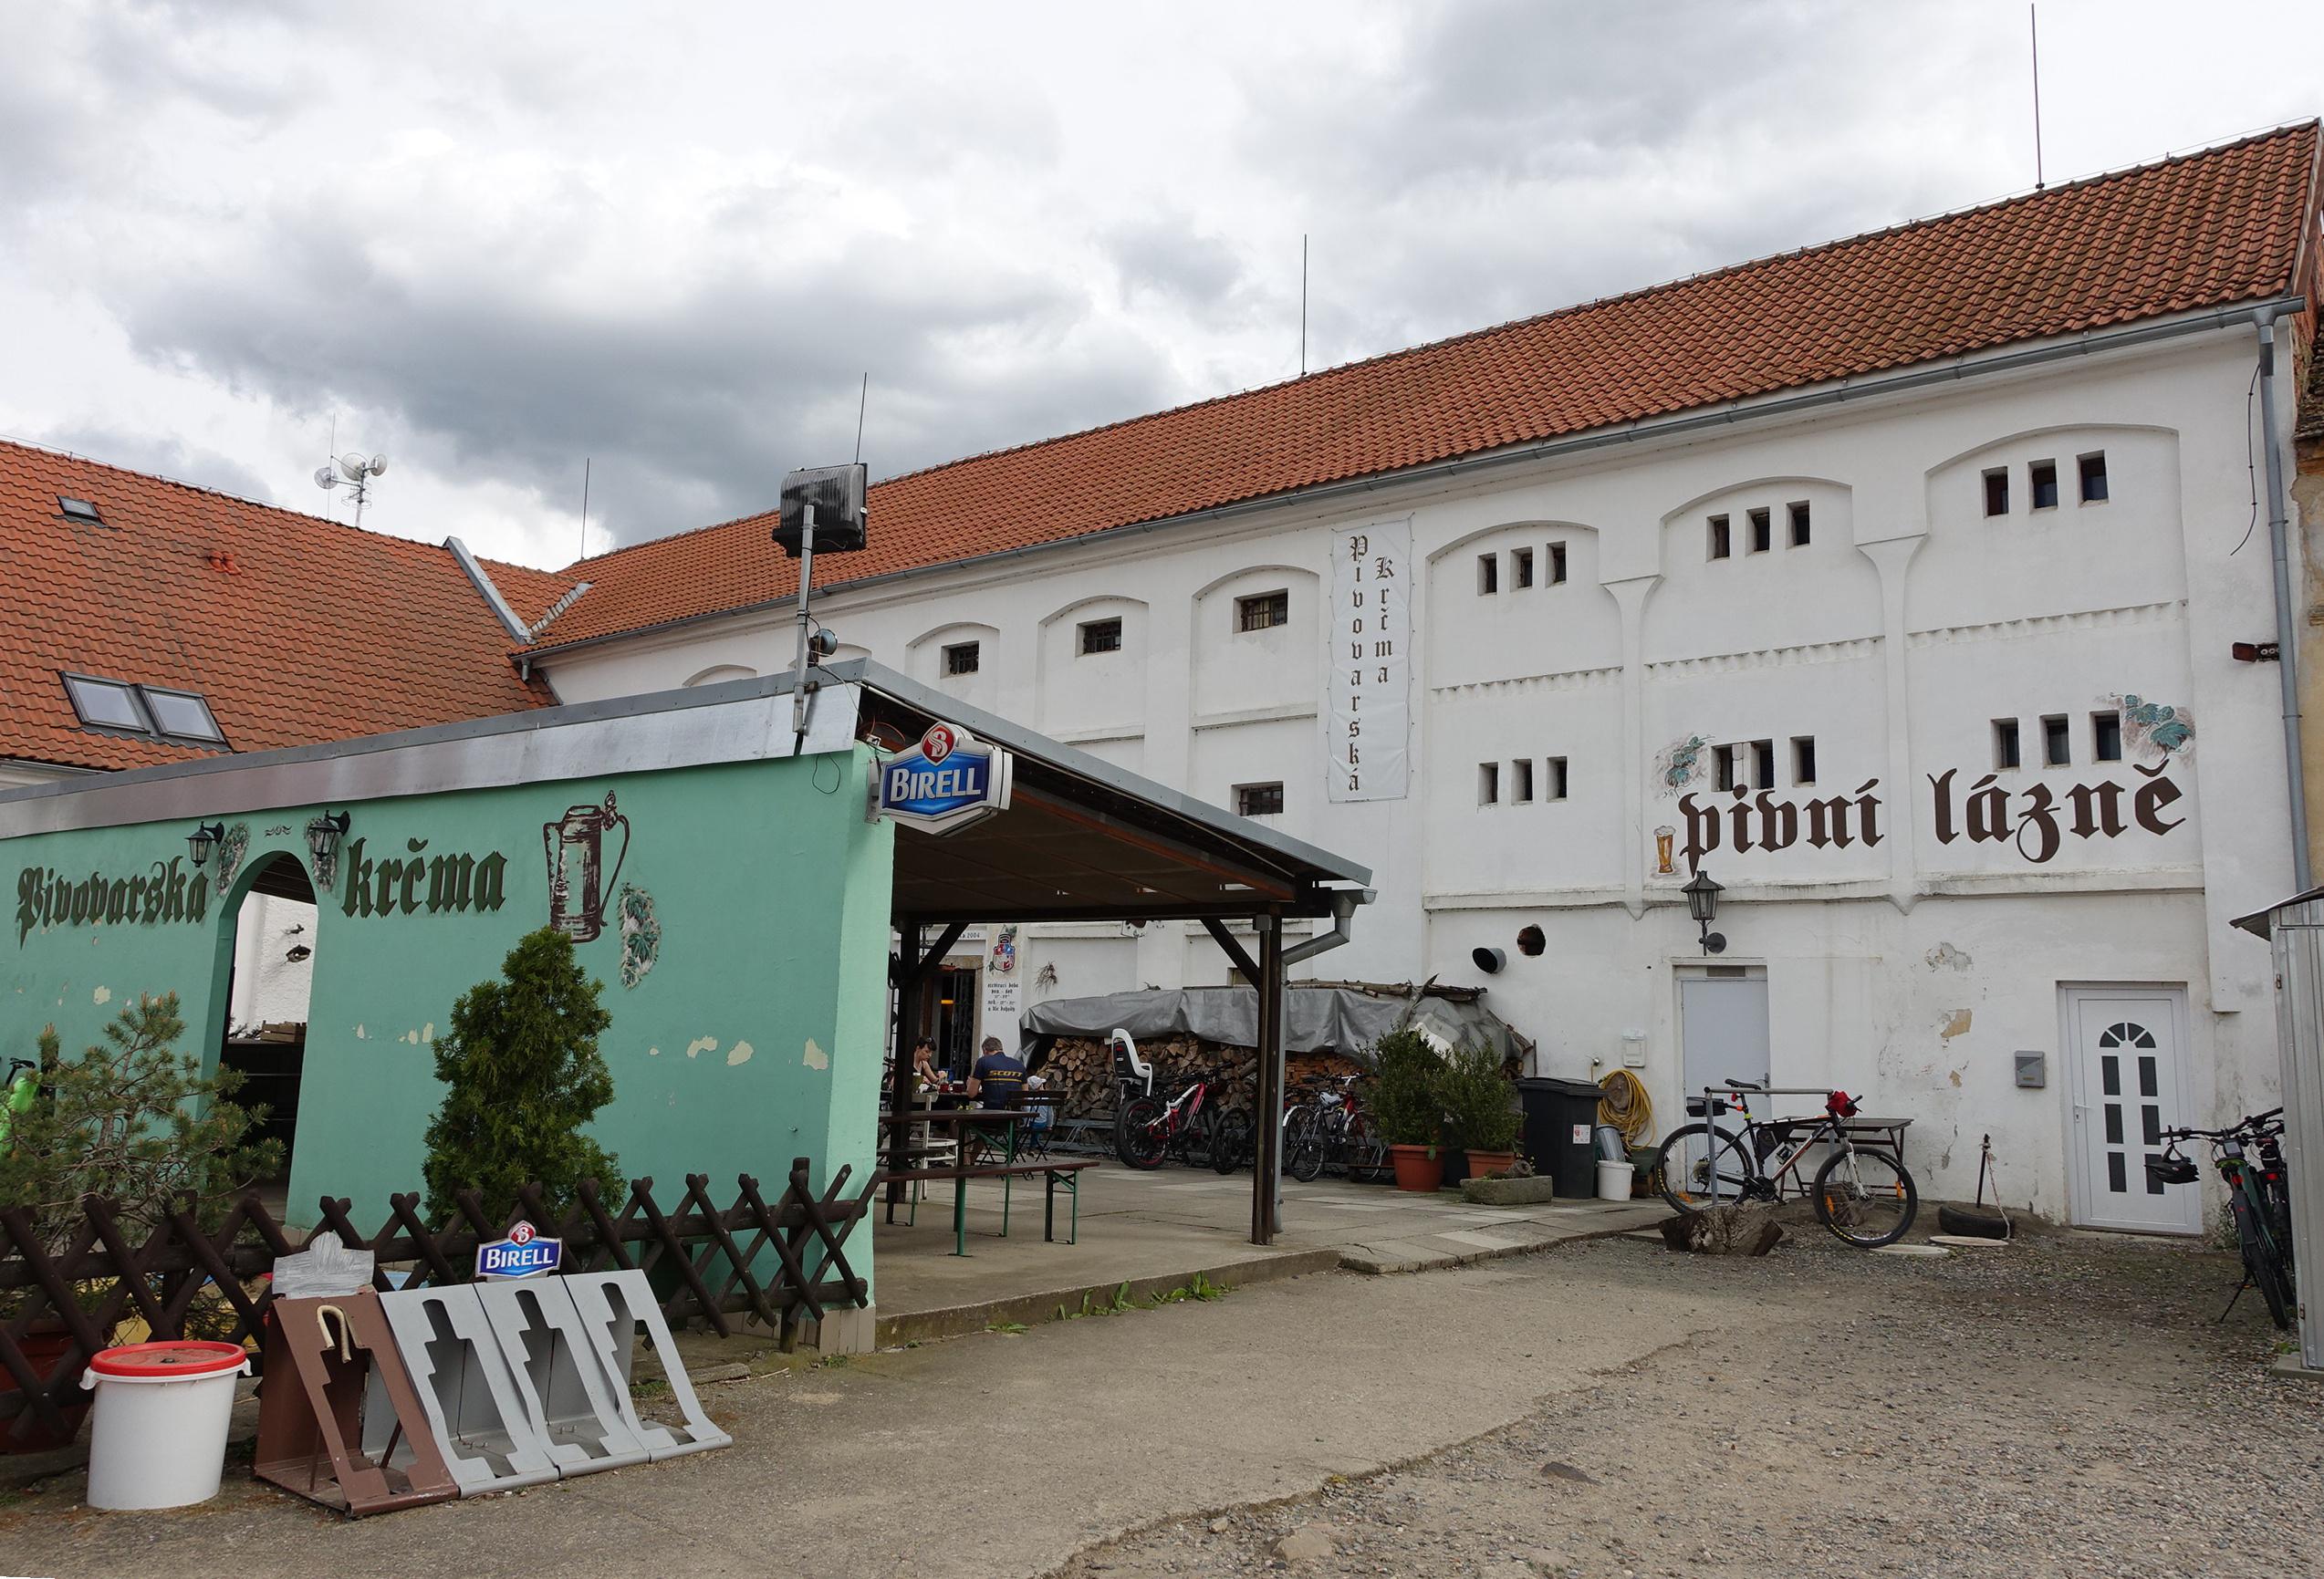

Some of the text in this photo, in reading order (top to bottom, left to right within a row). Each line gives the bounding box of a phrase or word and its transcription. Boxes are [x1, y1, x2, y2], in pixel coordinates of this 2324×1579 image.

[1349, 535, 1370, 792] Pivovarská
[1375, 556, 1395, 684] Krčma
[890, 767, 982, 802] BIRELL
[1678, 759, 2186, 878] pivní lázně
[341, 836, 508, 919] krčma
[486, 1248, 554, 1269] BIRELL
